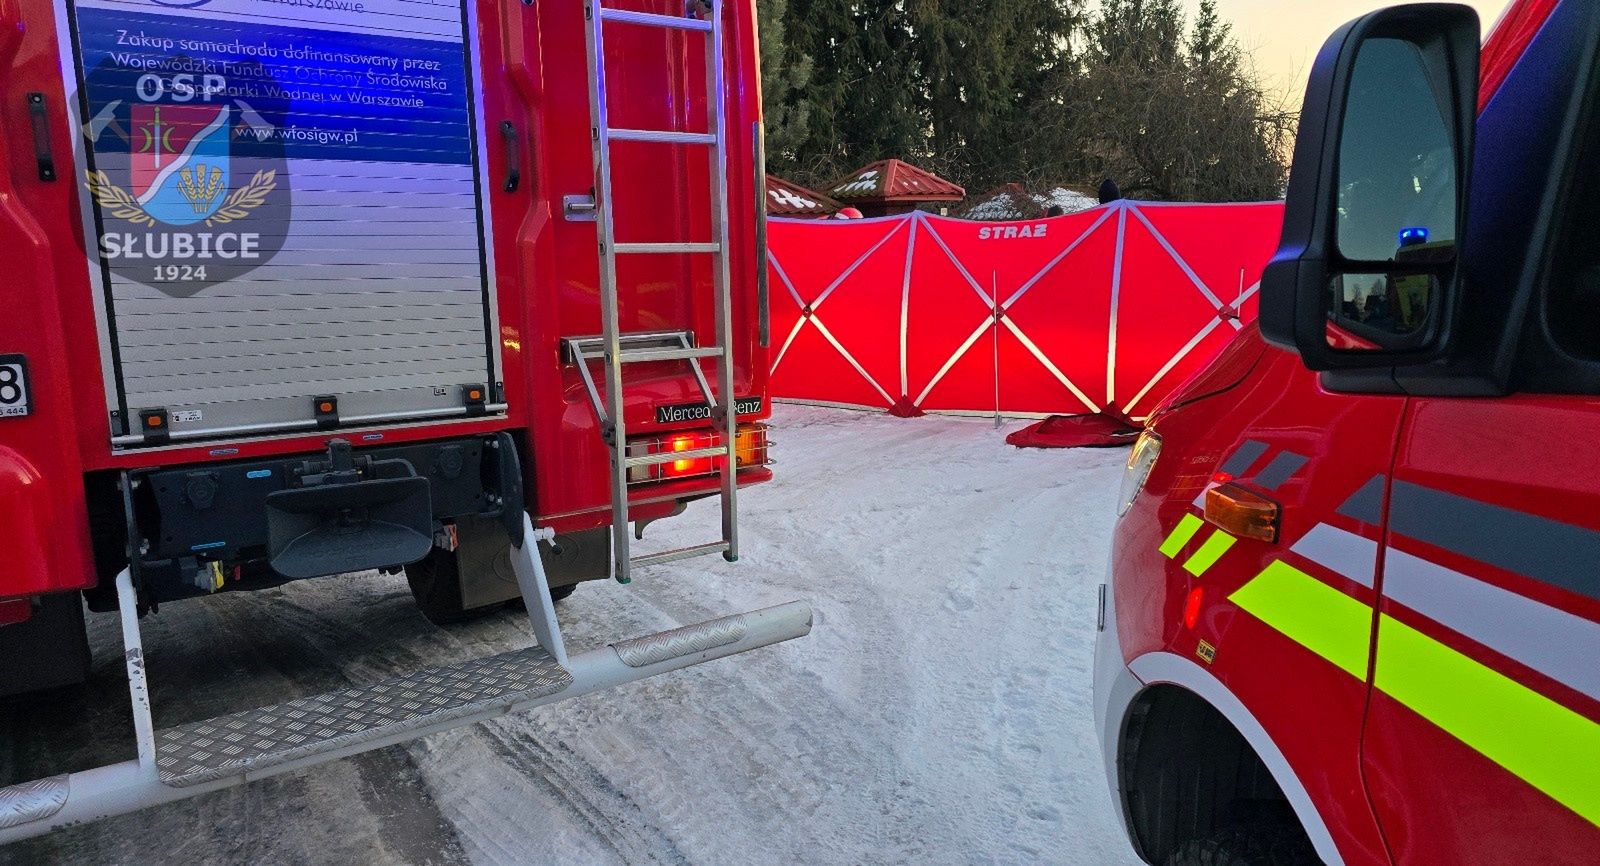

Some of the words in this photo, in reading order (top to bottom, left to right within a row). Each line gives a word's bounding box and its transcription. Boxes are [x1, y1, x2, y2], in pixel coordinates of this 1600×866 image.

[116, 29, 174, 51] Zakup
[180, 39, 278, 57] samochodu
[283, 44, 398, 69] dofinansowany
[403, 57, 441, 71] przez
[109, 51, 216, 74] Wojewódzki
[223, 60, 289, 79] Fundusz
[295, 66, 362, 87] Ochrony
[366, 68, 447, 90] Środowiska
[264, 85, 324, 104] Wodnej
[330, 93, 342, 101] w
[348, 91, 424, 108] Warszawie
[235, 124, 358, 144] www.wfosigw.pl
